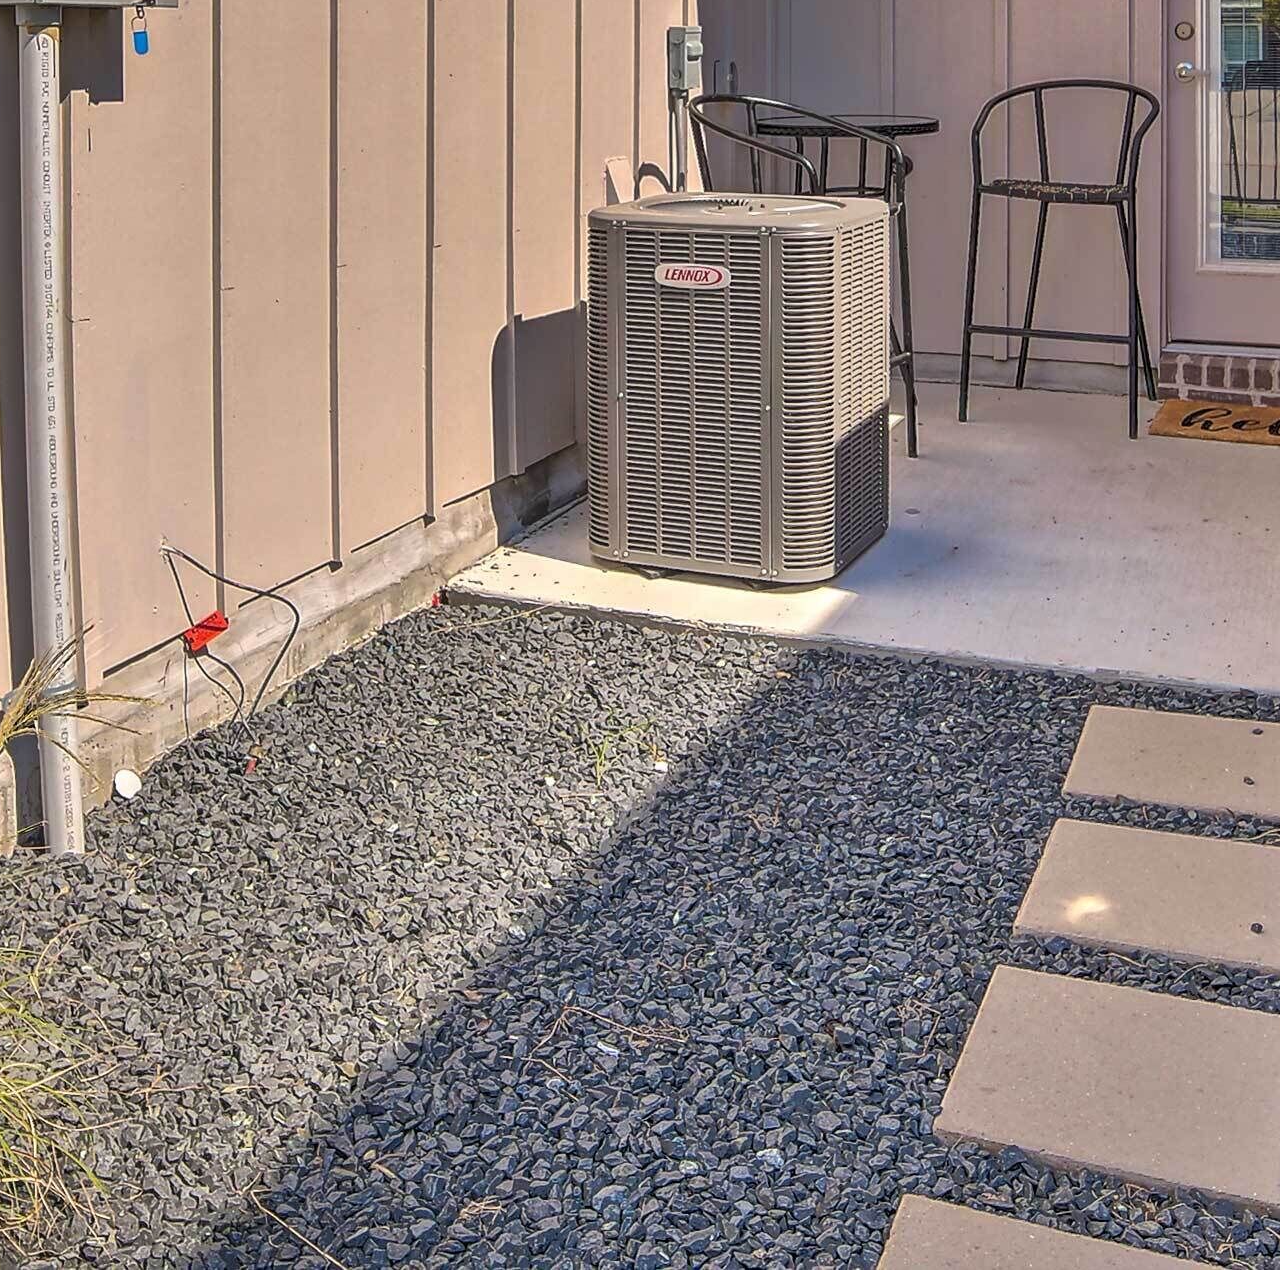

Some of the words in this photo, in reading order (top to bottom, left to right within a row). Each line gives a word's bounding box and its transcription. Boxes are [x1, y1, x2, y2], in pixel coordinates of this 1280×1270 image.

[41, 52, 50, 78] RIGID
[41, 81, 50, 97] PVC
[41, 101, 50, 156] NONMETALLIC
[43, 161, 52, 194] CONDUIT
[44, 250, 53, 280] LISTED
[664, 268, 711, 282] LENNOX
[46, 322, 55, 362] CONFORMS
[47, 367, 55, 378] TO
[47, 381, 56, 392] UL
[47, 396, 56, 412] STD
